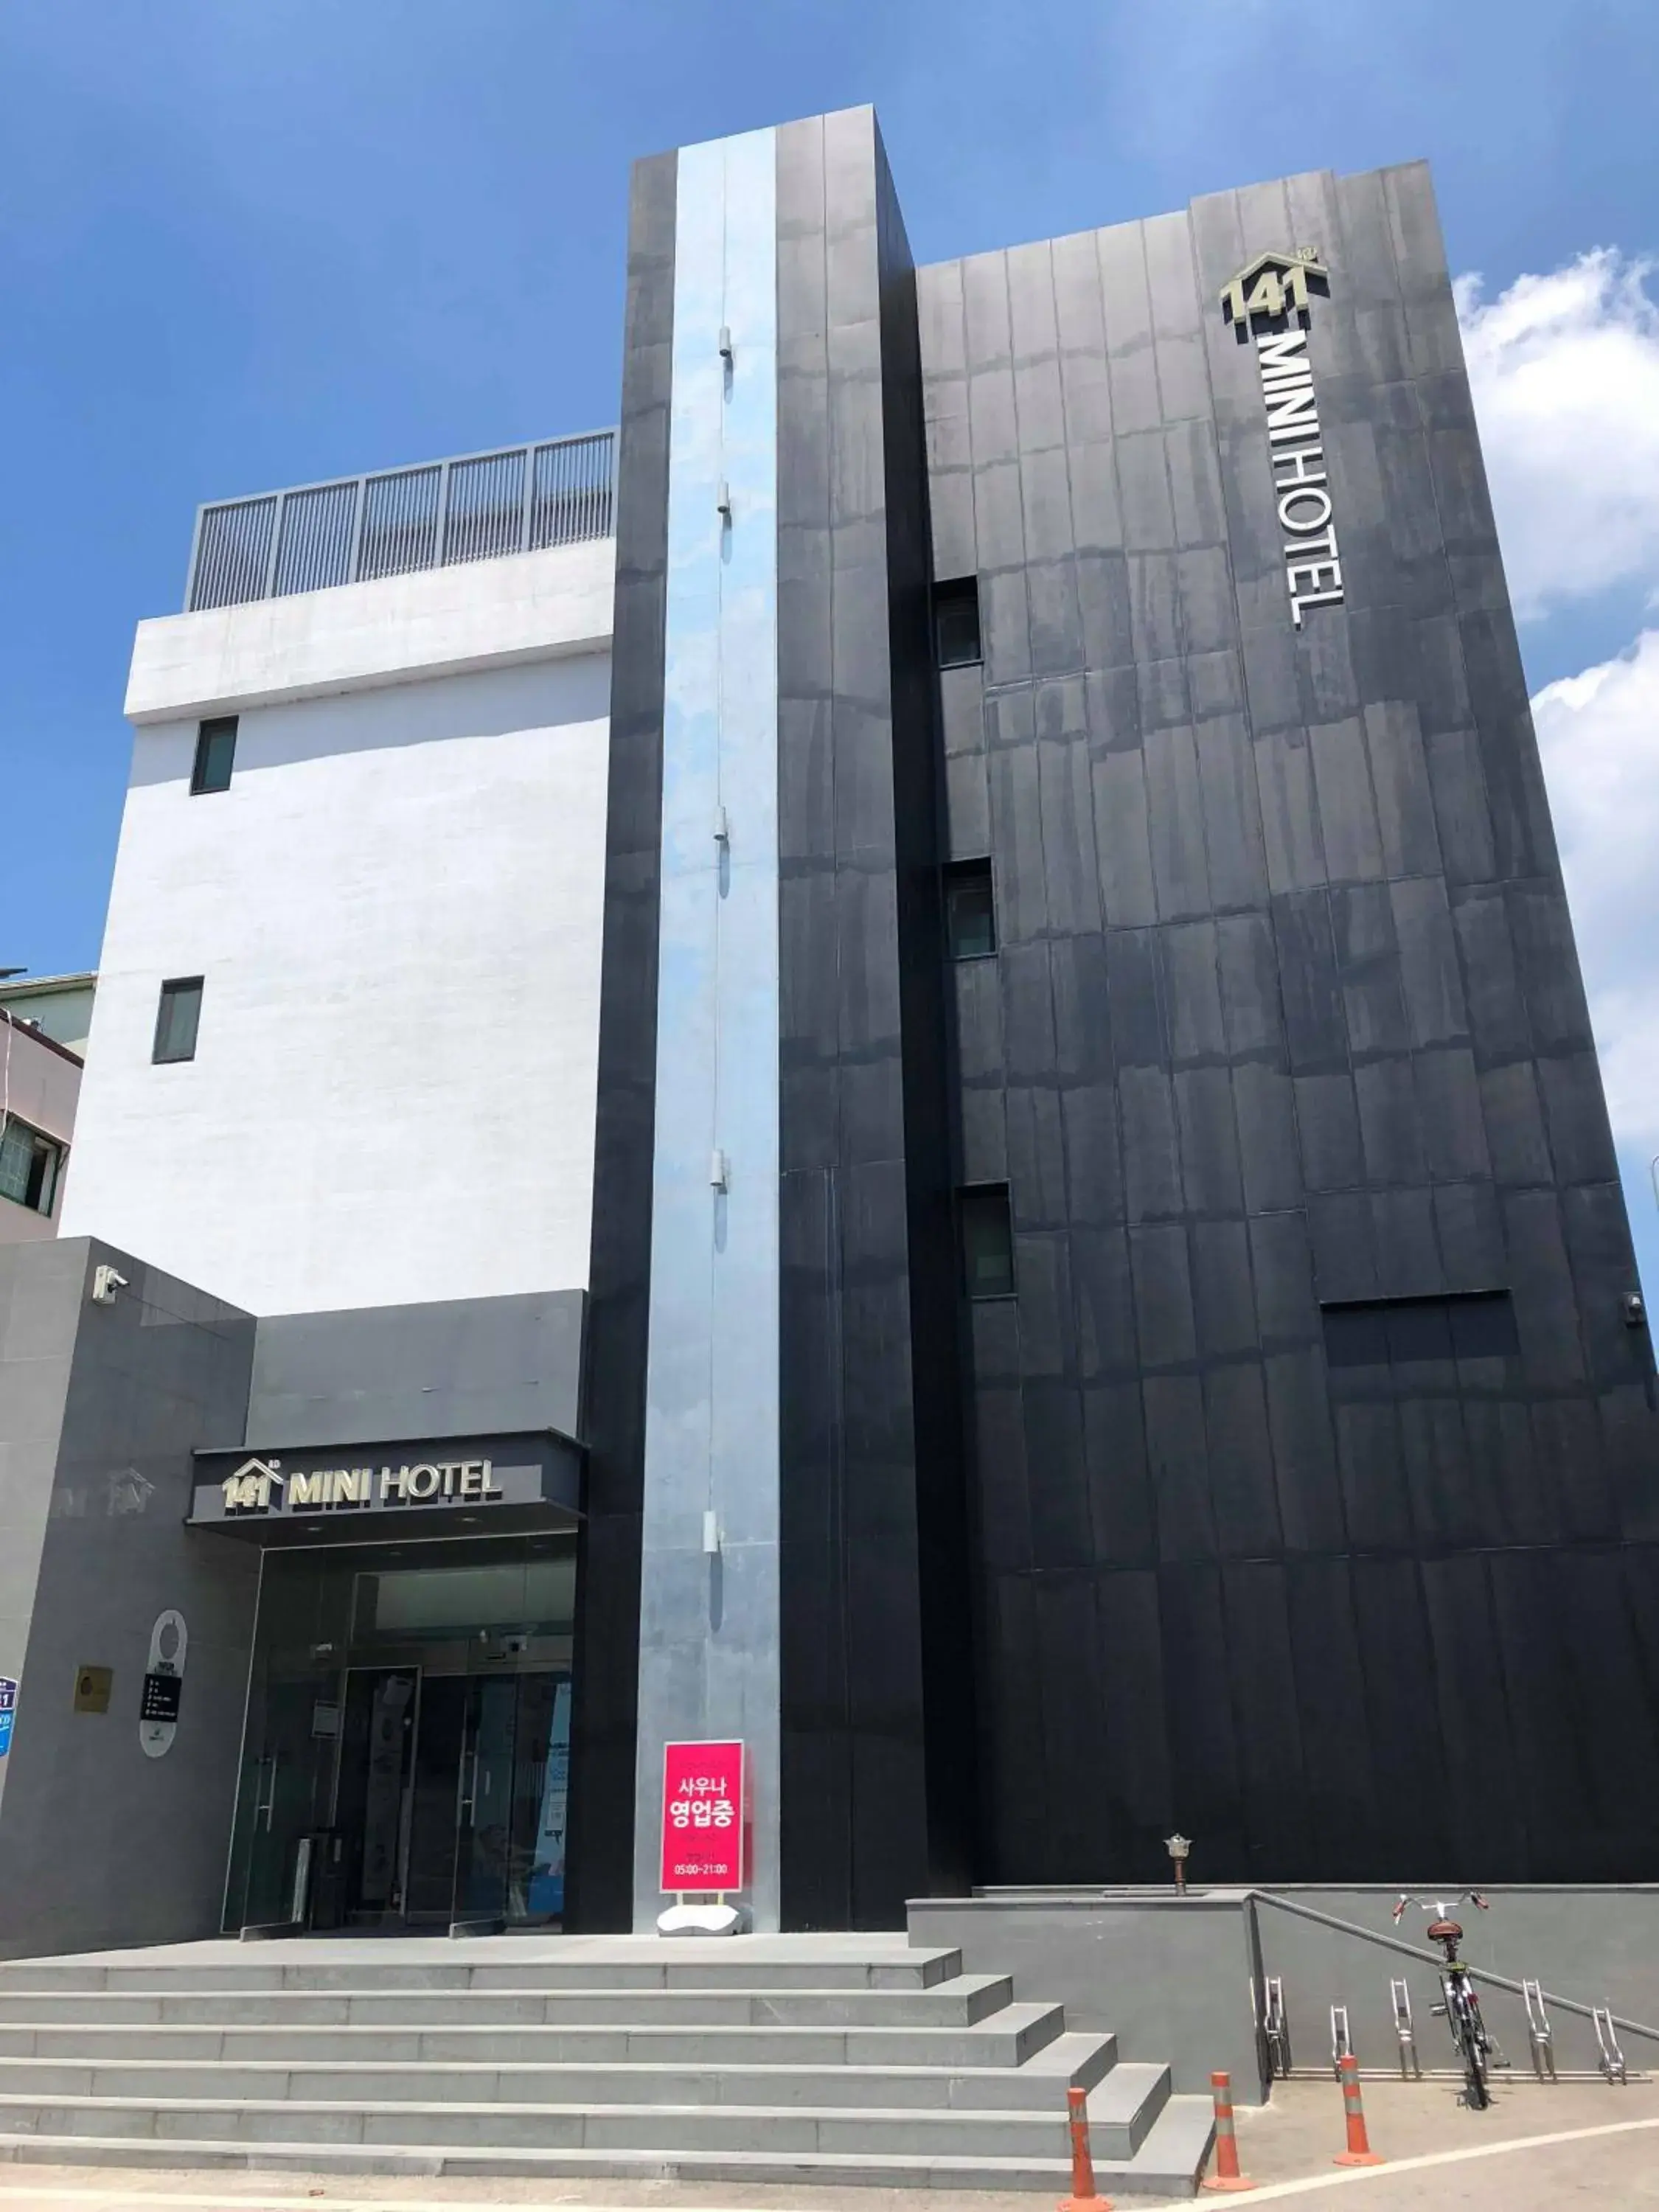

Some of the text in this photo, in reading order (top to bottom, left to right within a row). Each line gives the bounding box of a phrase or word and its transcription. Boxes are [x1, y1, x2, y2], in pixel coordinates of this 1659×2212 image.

[1220, 265, 1309, 325] 141
[1256, 329, 1345, 627] MINI HOTEL
[224, 1458, 504, 1508] 141 MINI HOTEL
[678, 1775, 728, 1797] 사우나
[669, 1799, 736, 1829] 영업중
